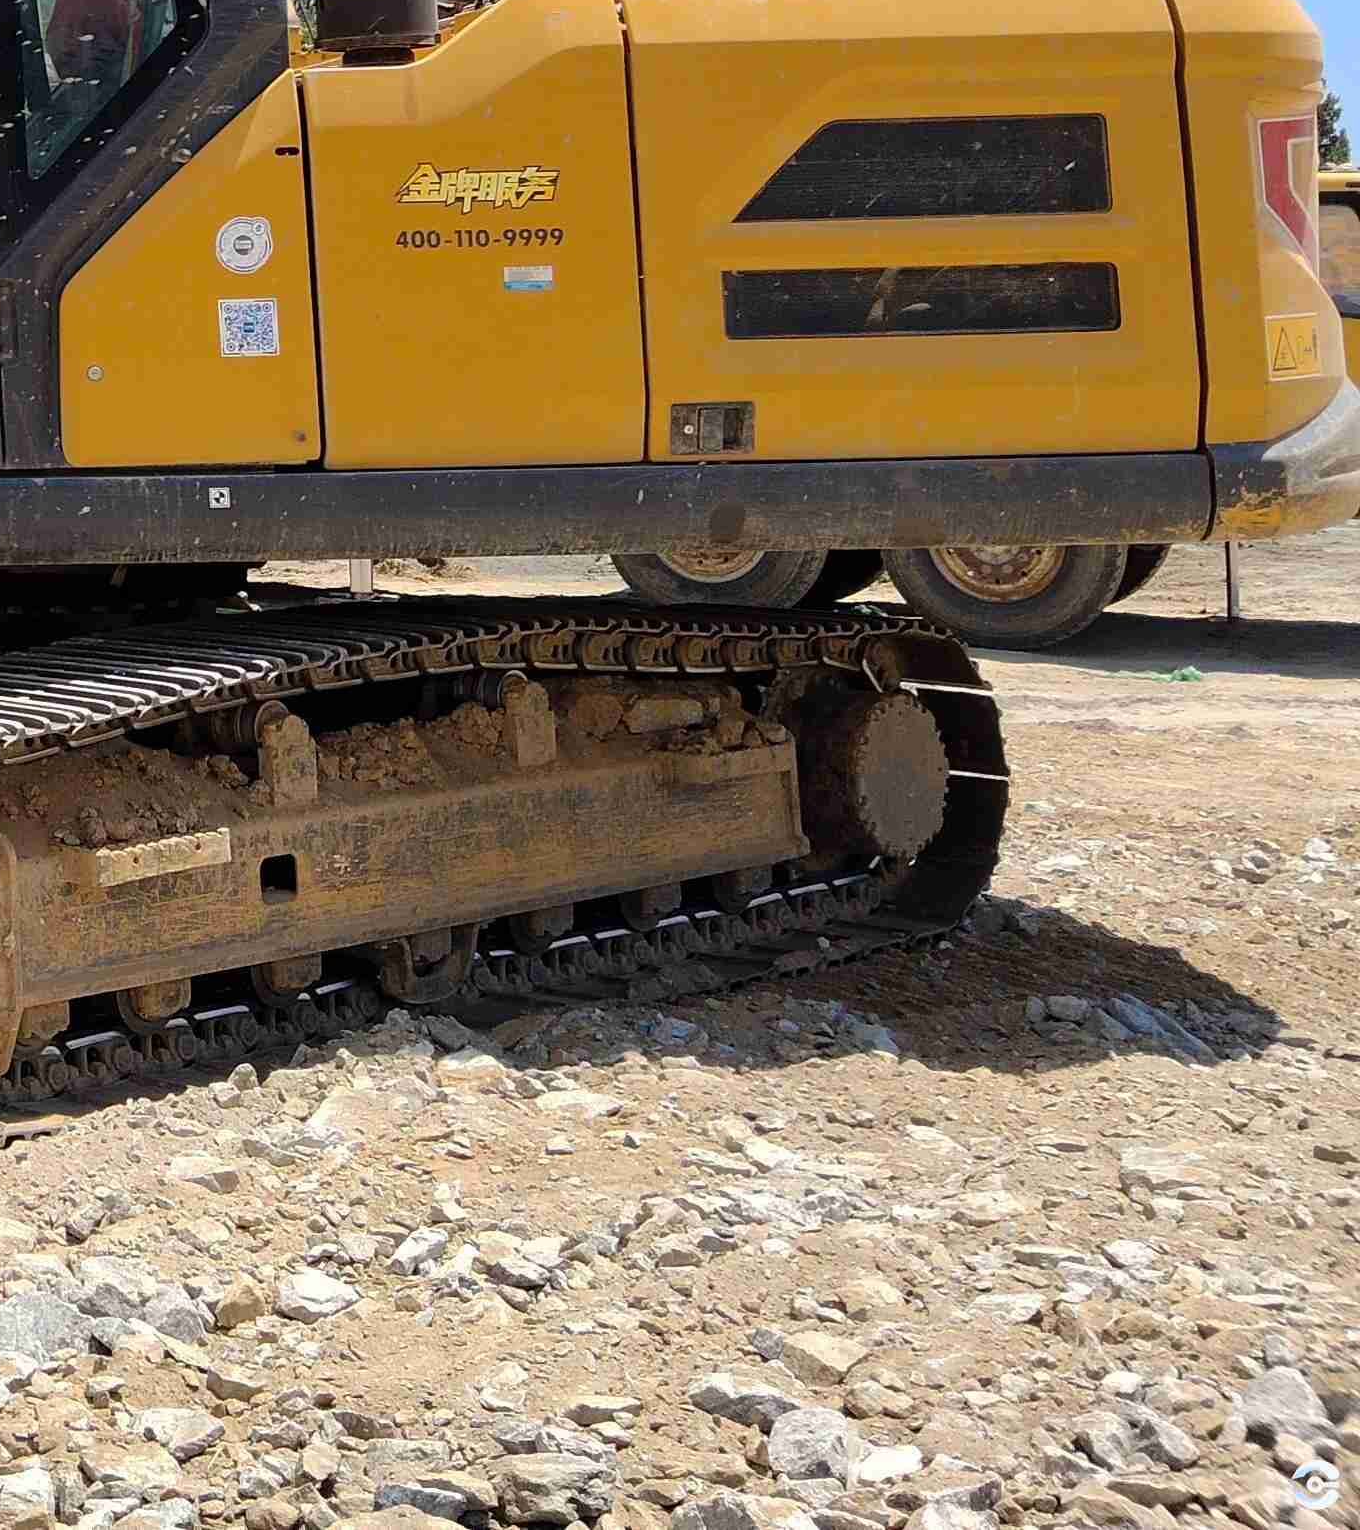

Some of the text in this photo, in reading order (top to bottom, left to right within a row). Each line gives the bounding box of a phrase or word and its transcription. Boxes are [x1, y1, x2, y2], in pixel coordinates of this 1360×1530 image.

[394, 162, 561, 214] 金牌服务
[396, 228, 564, 249] 400-110-9999
